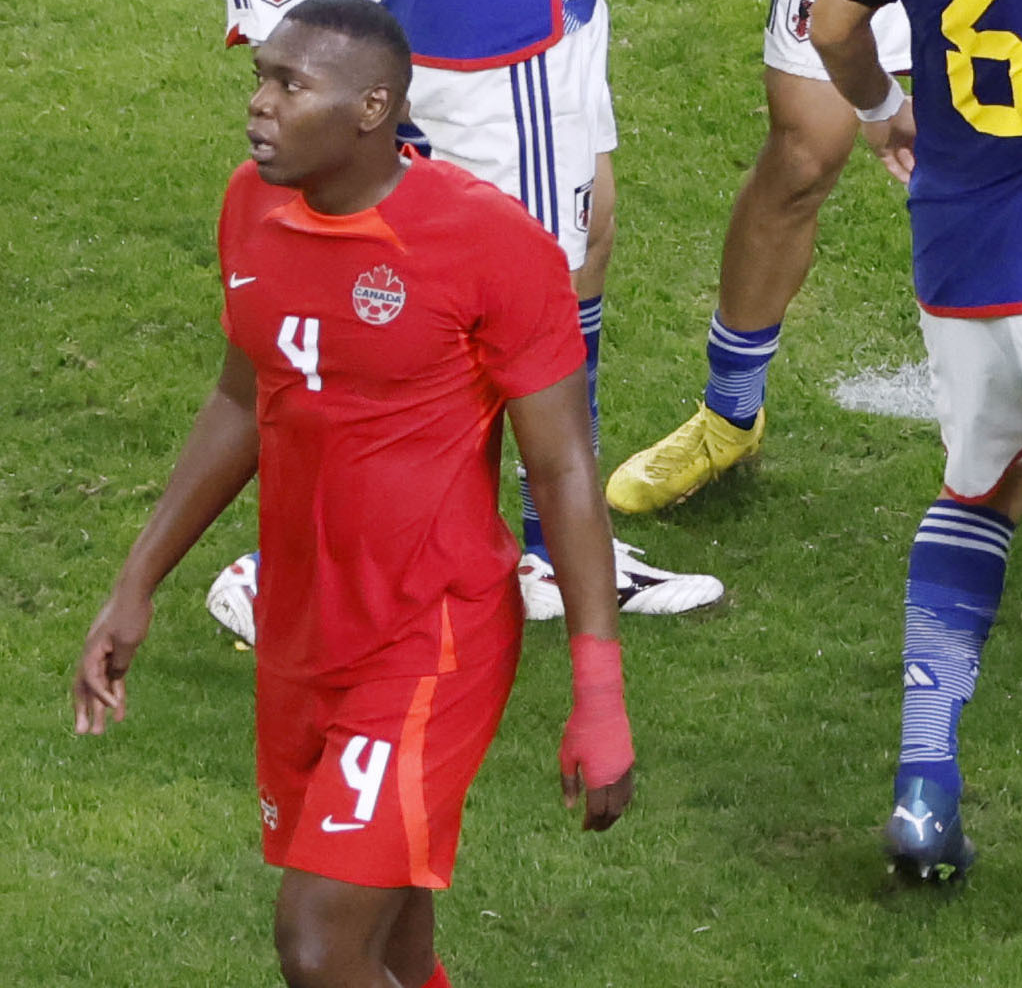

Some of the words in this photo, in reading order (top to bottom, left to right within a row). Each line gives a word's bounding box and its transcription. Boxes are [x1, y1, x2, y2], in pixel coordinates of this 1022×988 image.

[354, 287, 402, 303] CANADA
[277, 316, 322, 392] 4
[340, 735, 392, 822] 4
